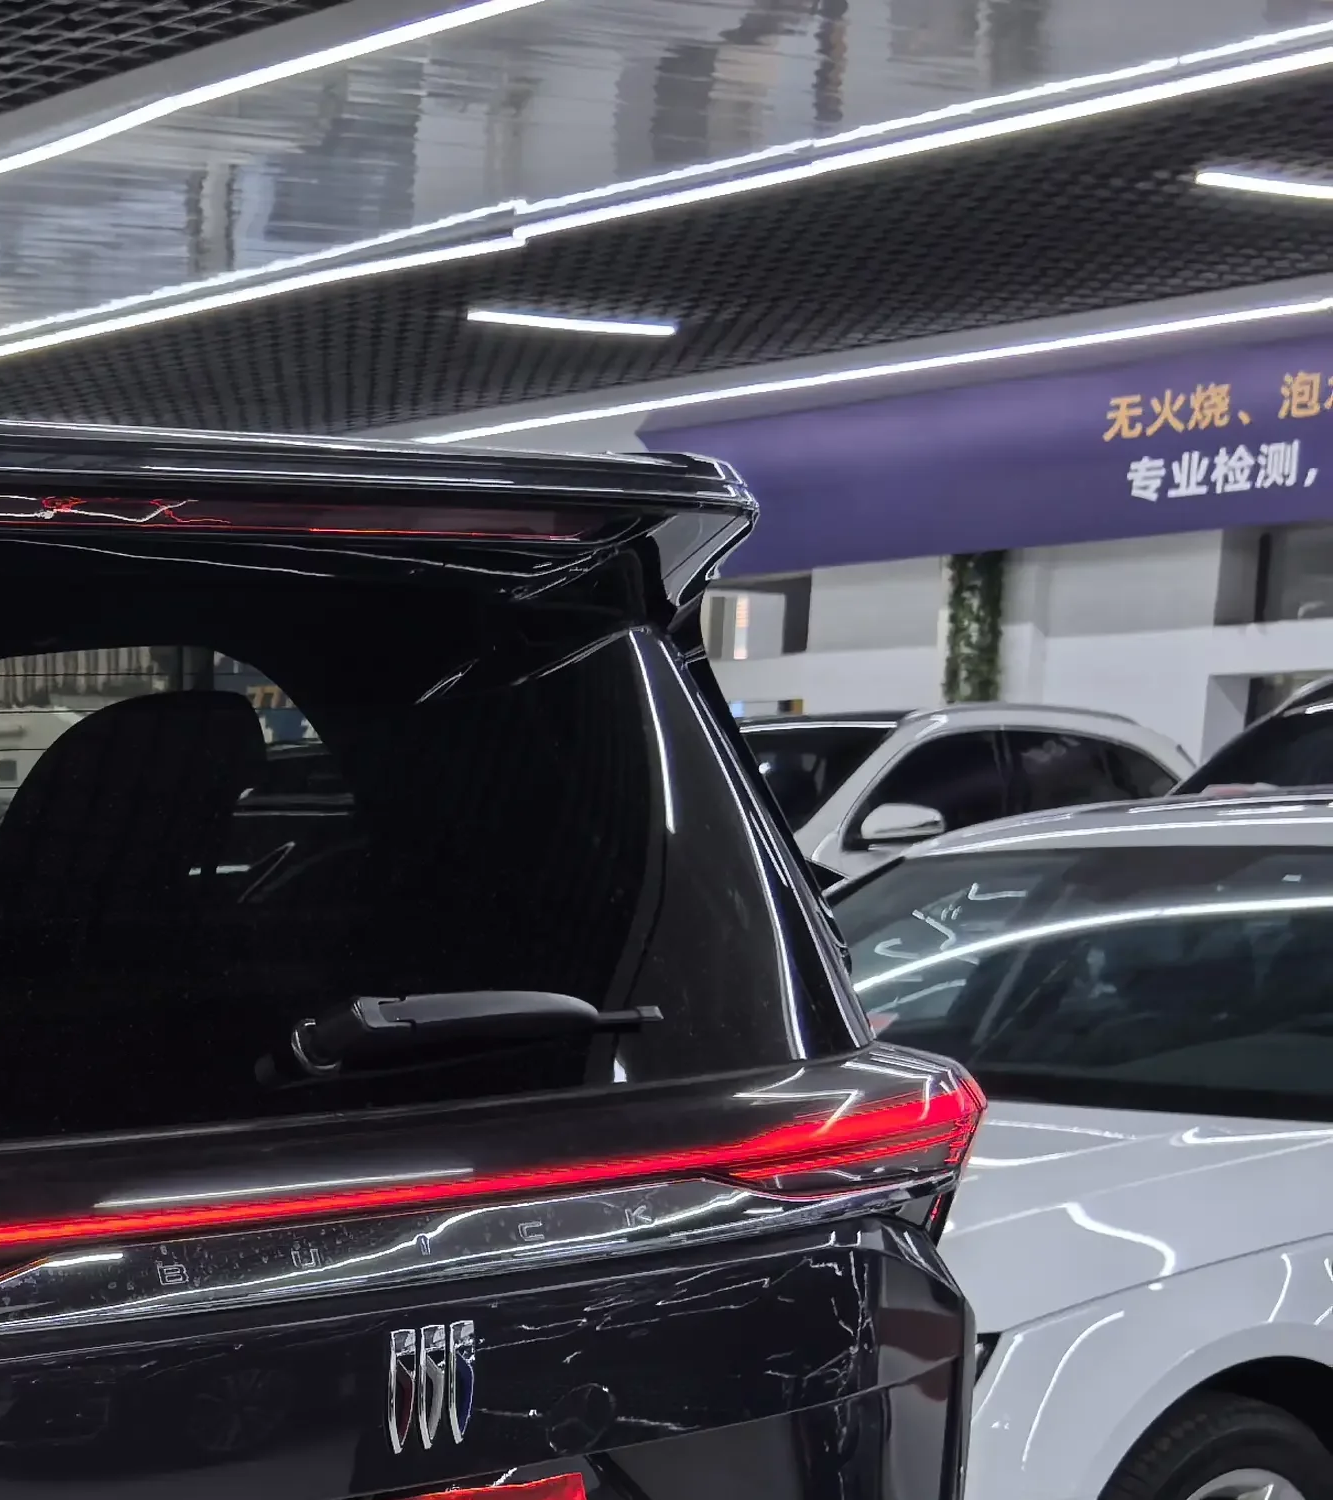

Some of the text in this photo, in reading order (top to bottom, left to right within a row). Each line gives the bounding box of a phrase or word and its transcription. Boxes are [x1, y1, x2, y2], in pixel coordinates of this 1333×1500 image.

[1102, 369, 1333, 442] 无火烧、泡
[156, 1204, 653, 1287] BUICK
